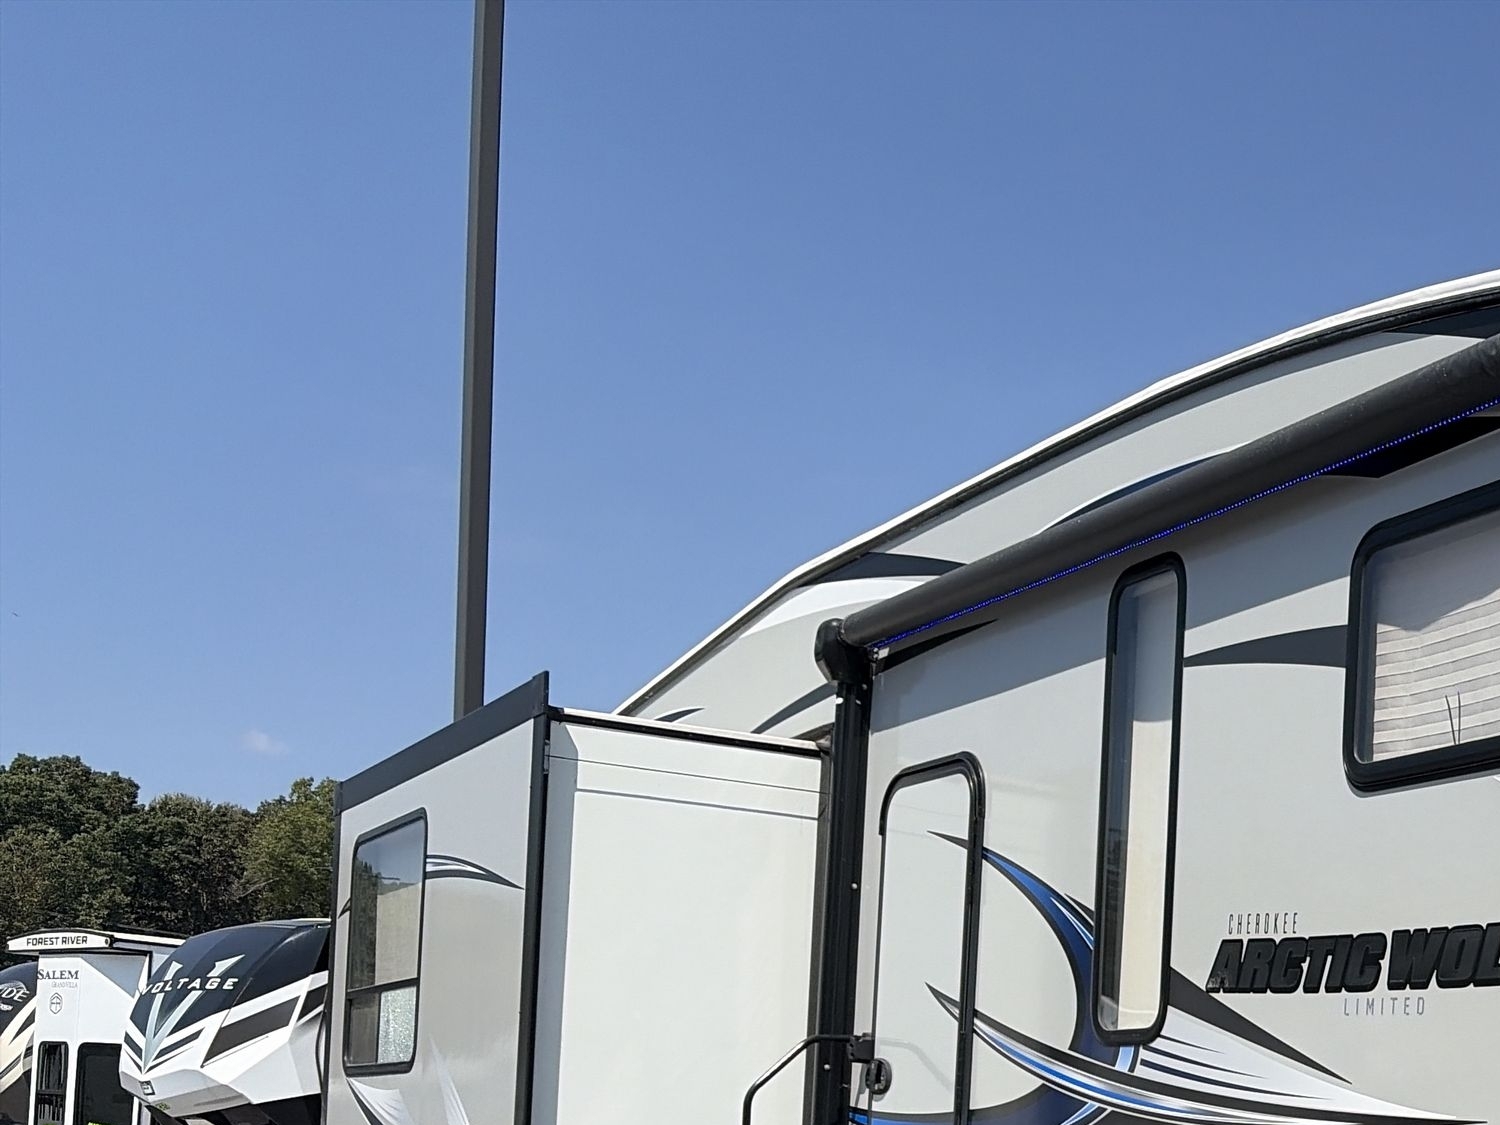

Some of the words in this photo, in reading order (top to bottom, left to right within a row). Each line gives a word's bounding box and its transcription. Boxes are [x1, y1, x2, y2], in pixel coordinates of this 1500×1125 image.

[1228, 912, 1299, 935] CHEROKEE
[26, 937, 60, 947] FOREST
[61, 935, 88, 945] RIVER
[1206, 931, 1388, 994] ARCTIC
[37, 968, 80, 980] SALEM
[141, 978, 239, 996] VOLTAGE
[1343, 996, 1426, 1016] LIMITED
